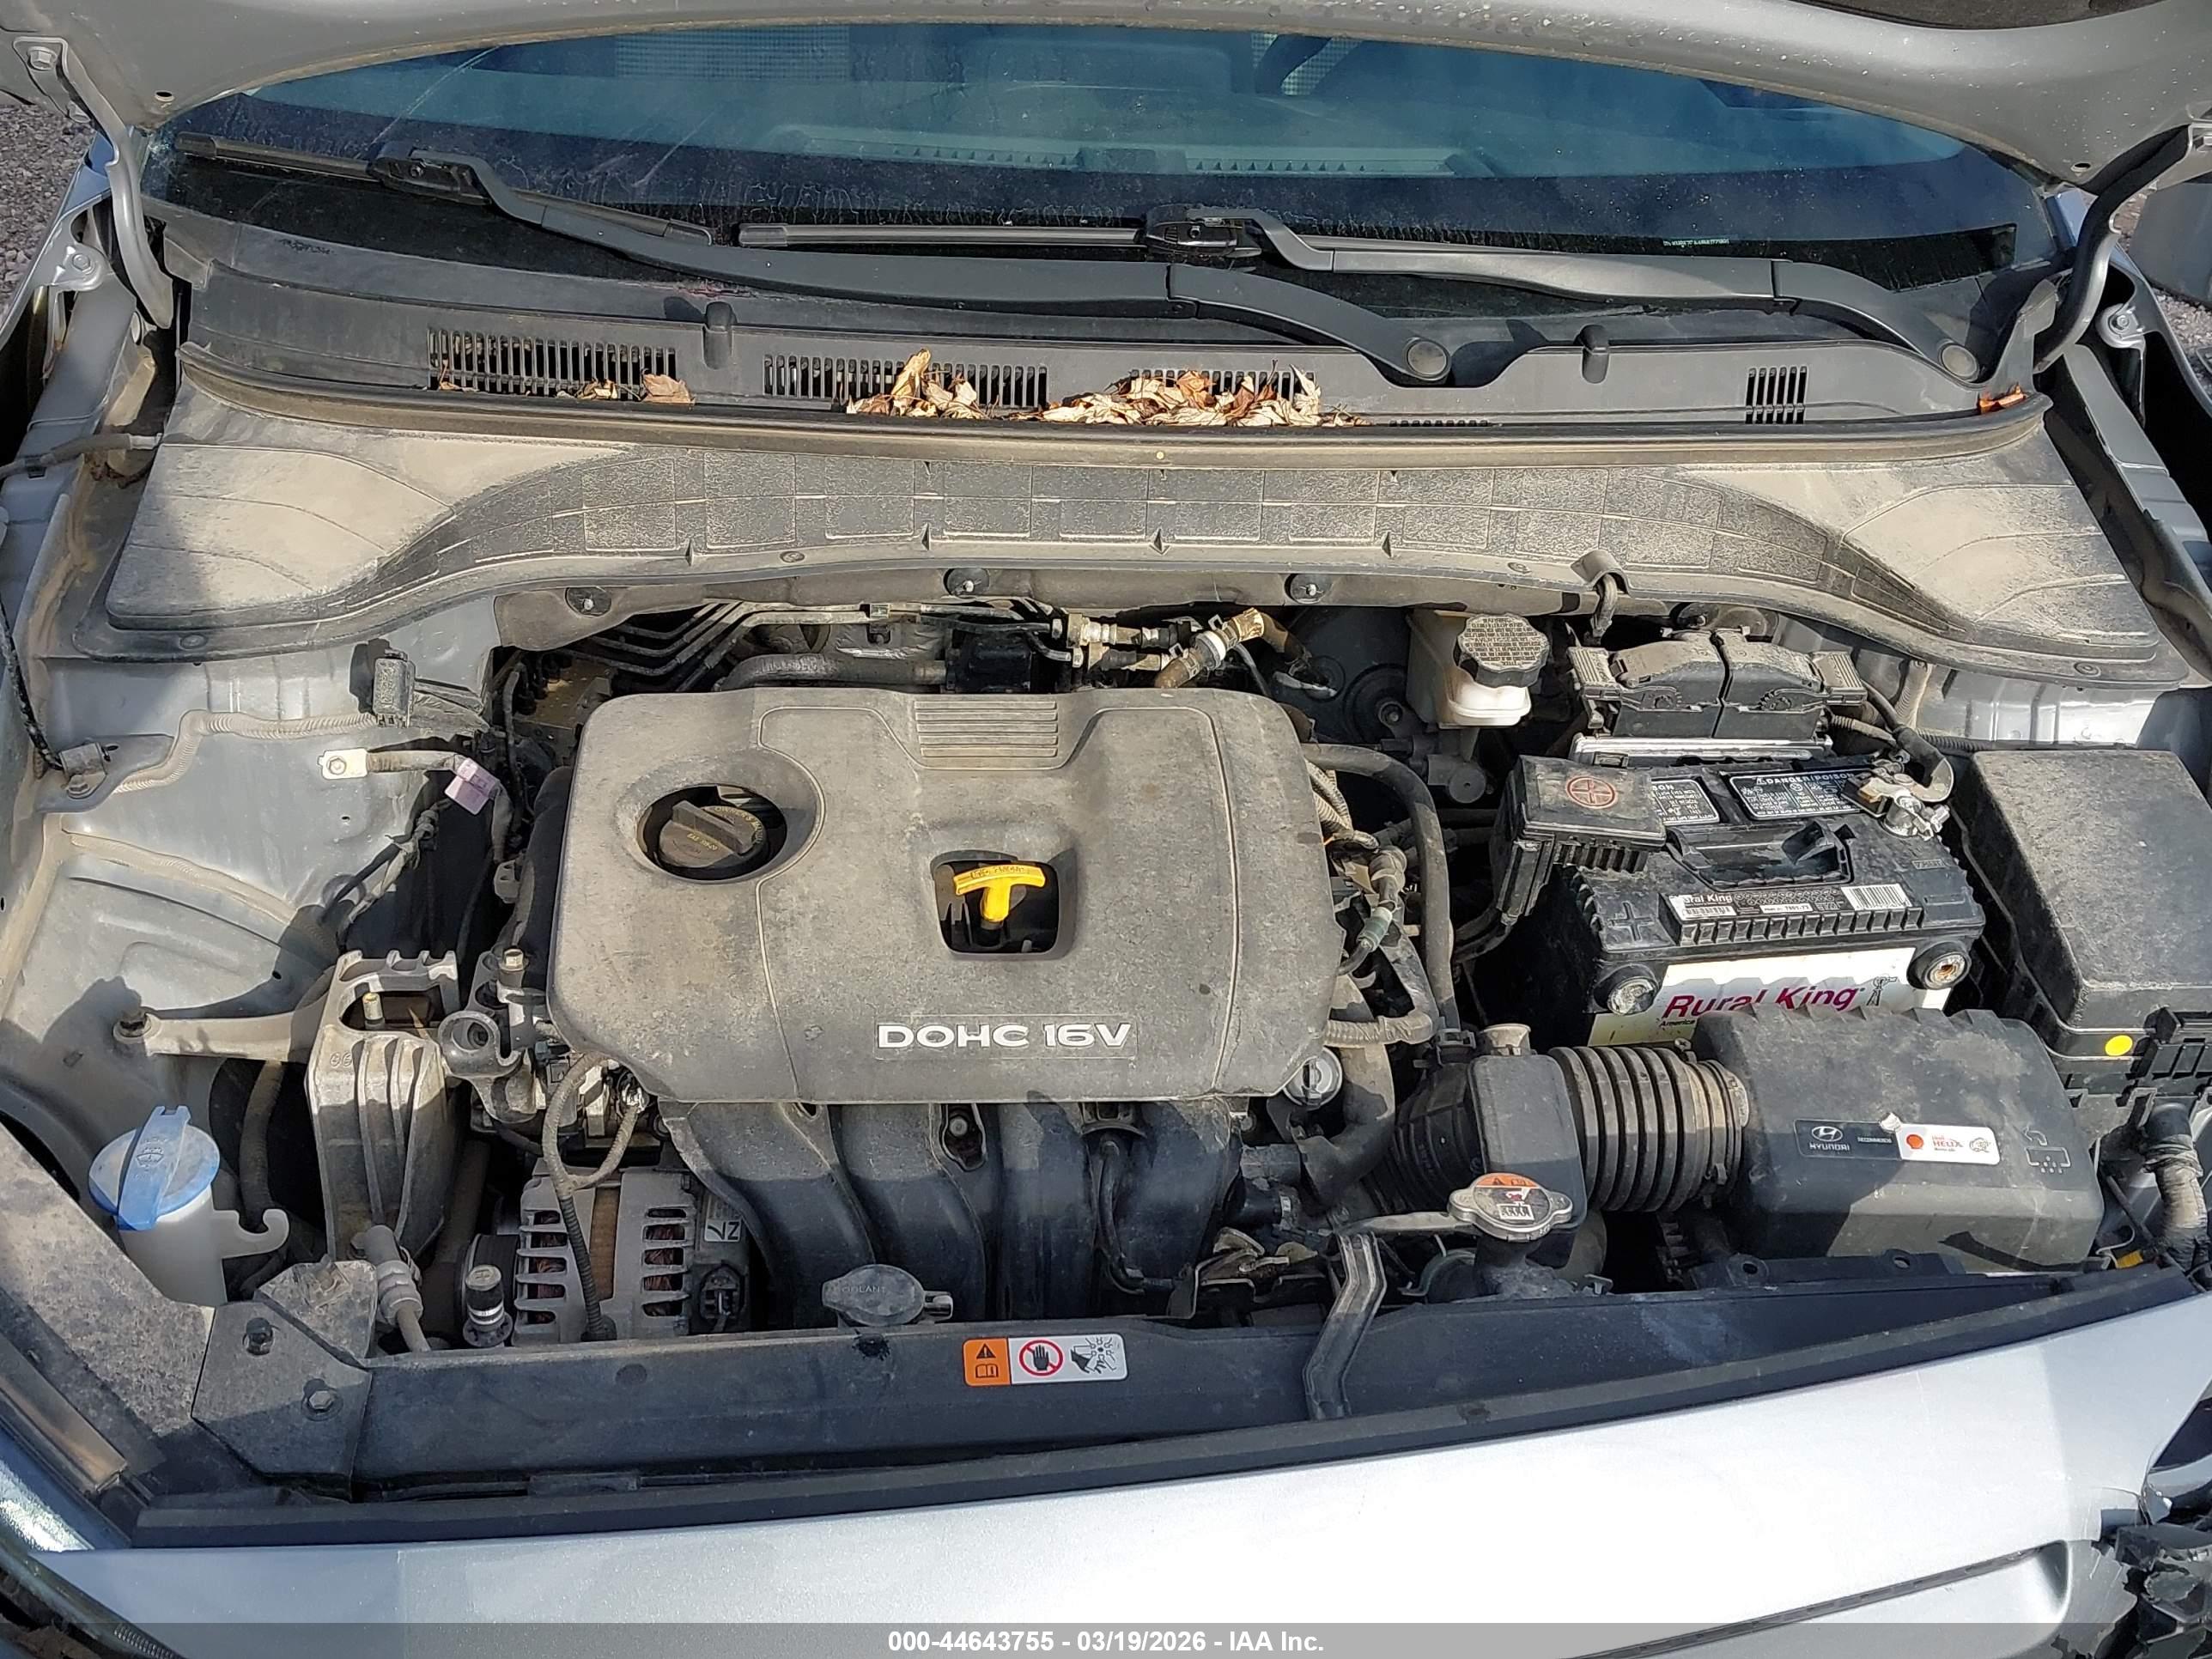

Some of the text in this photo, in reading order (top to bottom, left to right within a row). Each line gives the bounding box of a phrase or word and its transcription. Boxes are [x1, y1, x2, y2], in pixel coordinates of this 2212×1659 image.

[877, 1023, 1132, 1048] DOHC 16V
[1809, 1141, 1850, 1152] HYUNDAI
